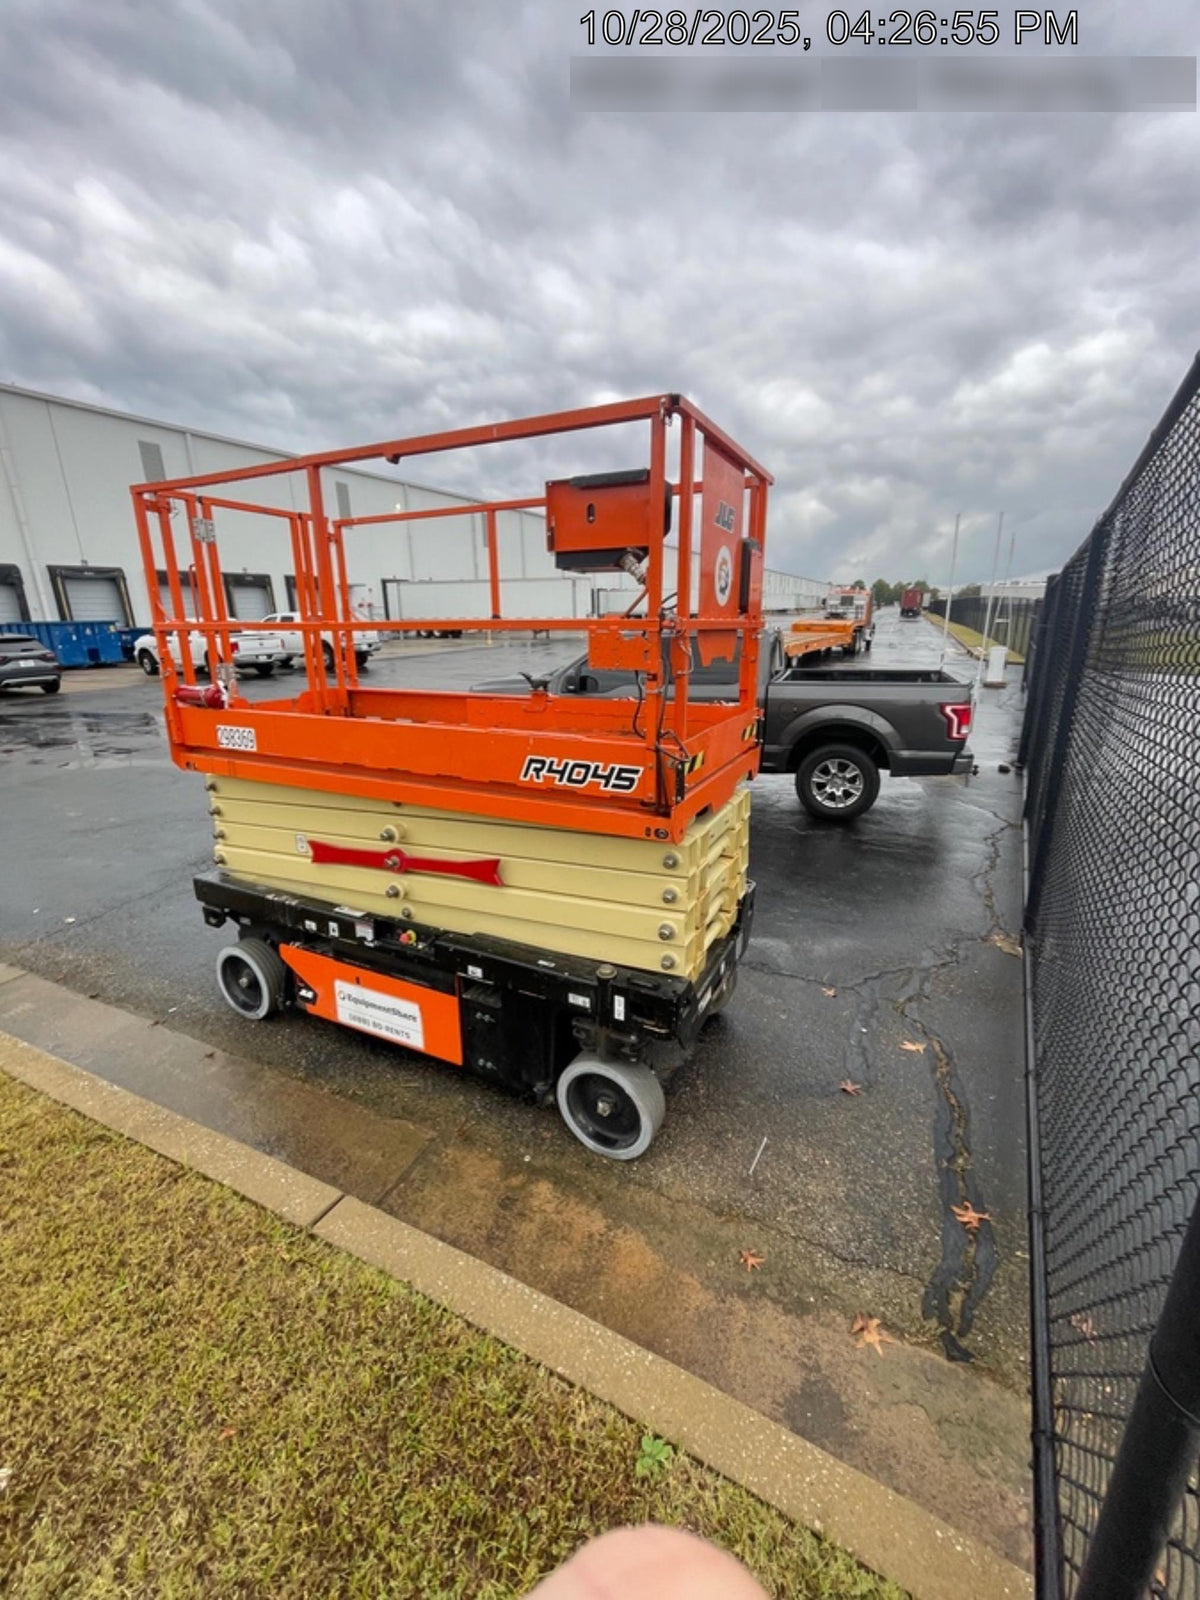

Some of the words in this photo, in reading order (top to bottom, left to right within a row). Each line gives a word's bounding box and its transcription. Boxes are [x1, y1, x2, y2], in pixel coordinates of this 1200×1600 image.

[714, 501, 736, 532] JLG
[521, 756, 642, 792] R4045
[346, 993, 418, 1022] EquipmentShare
